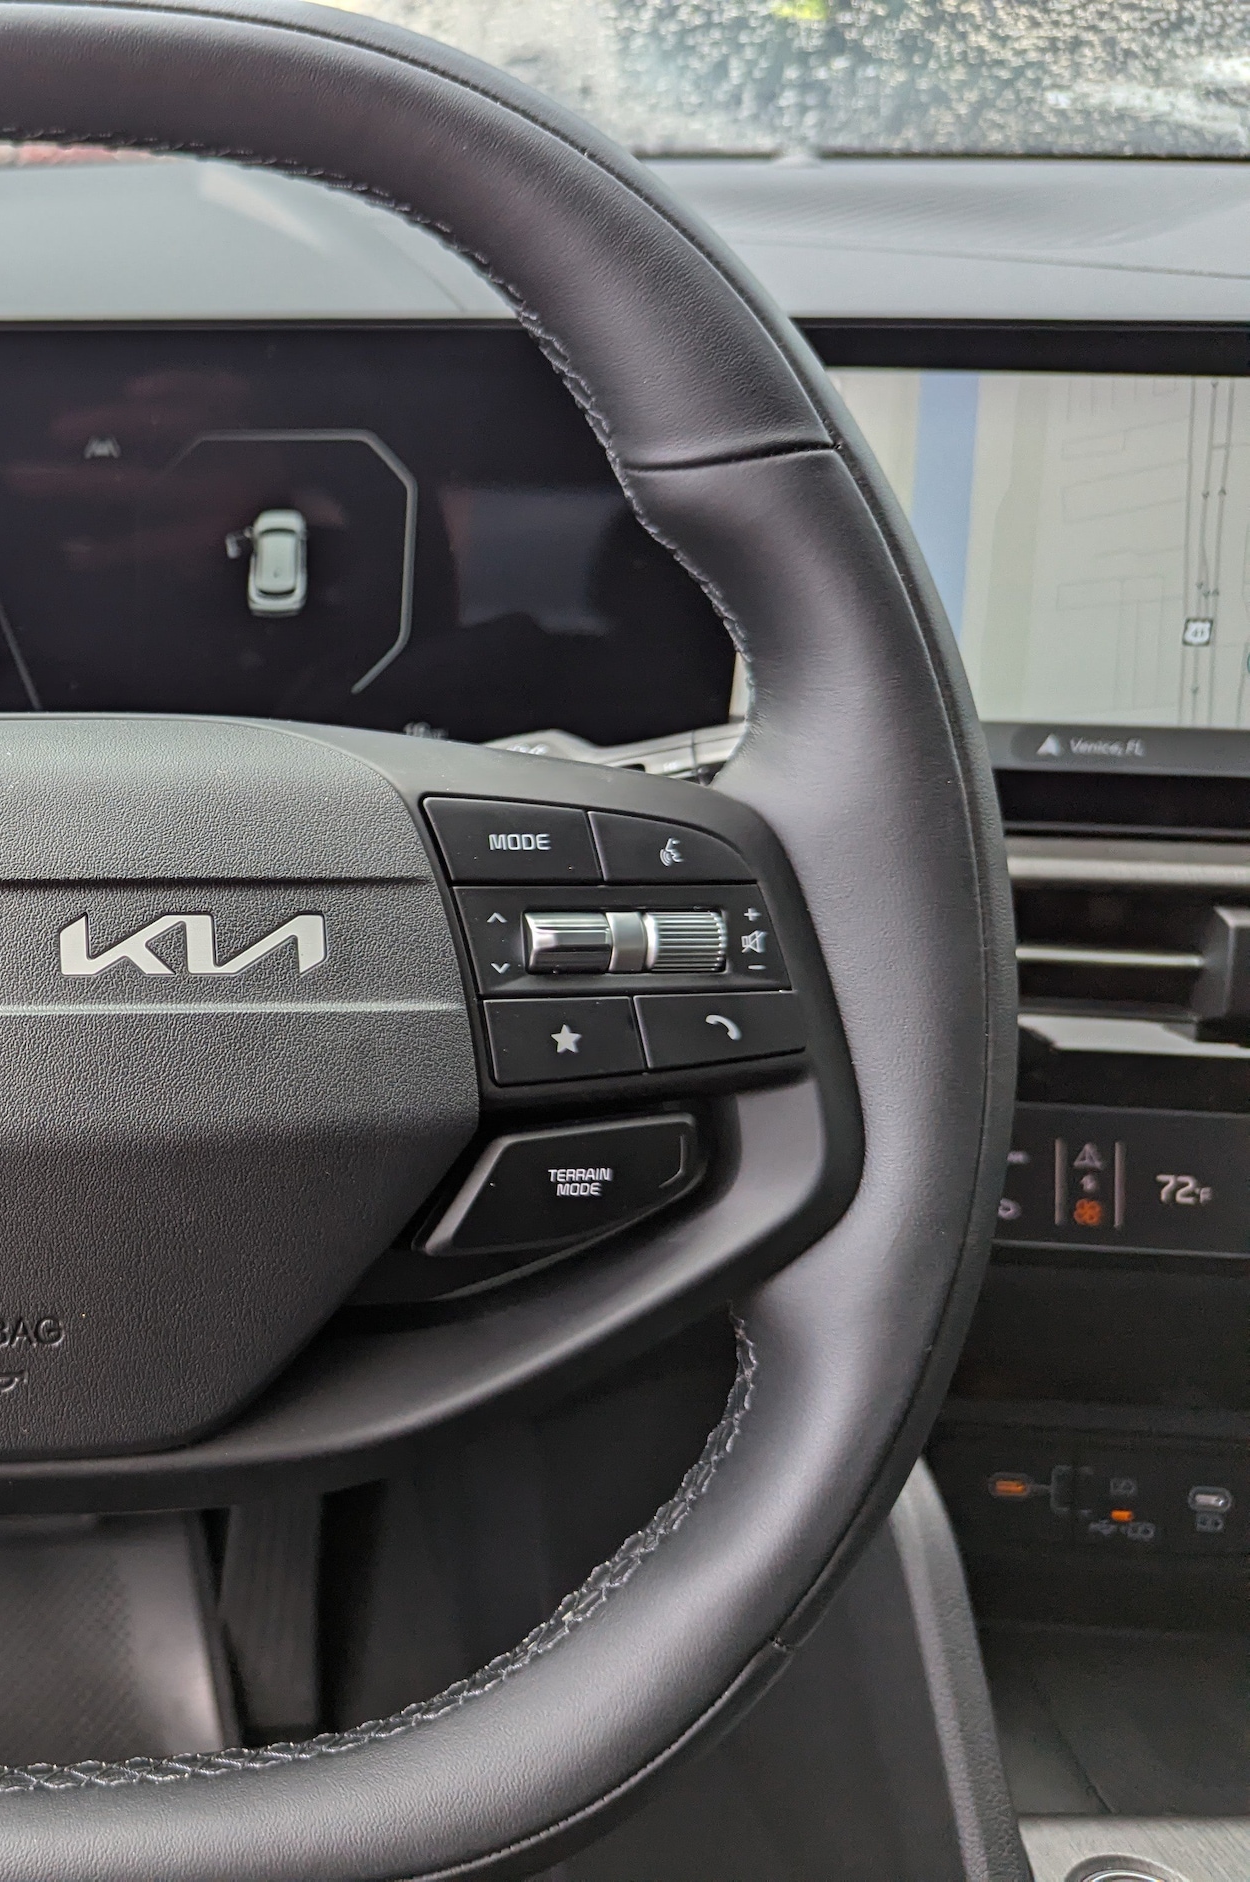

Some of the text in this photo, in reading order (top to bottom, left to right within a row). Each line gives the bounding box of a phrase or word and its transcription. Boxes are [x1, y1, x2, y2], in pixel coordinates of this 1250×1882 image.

[488, 833, 552, 852] MODE
[548, 1168, 613, 1183] TERRAIN
[556, 1183, 602, 1197] MODE
